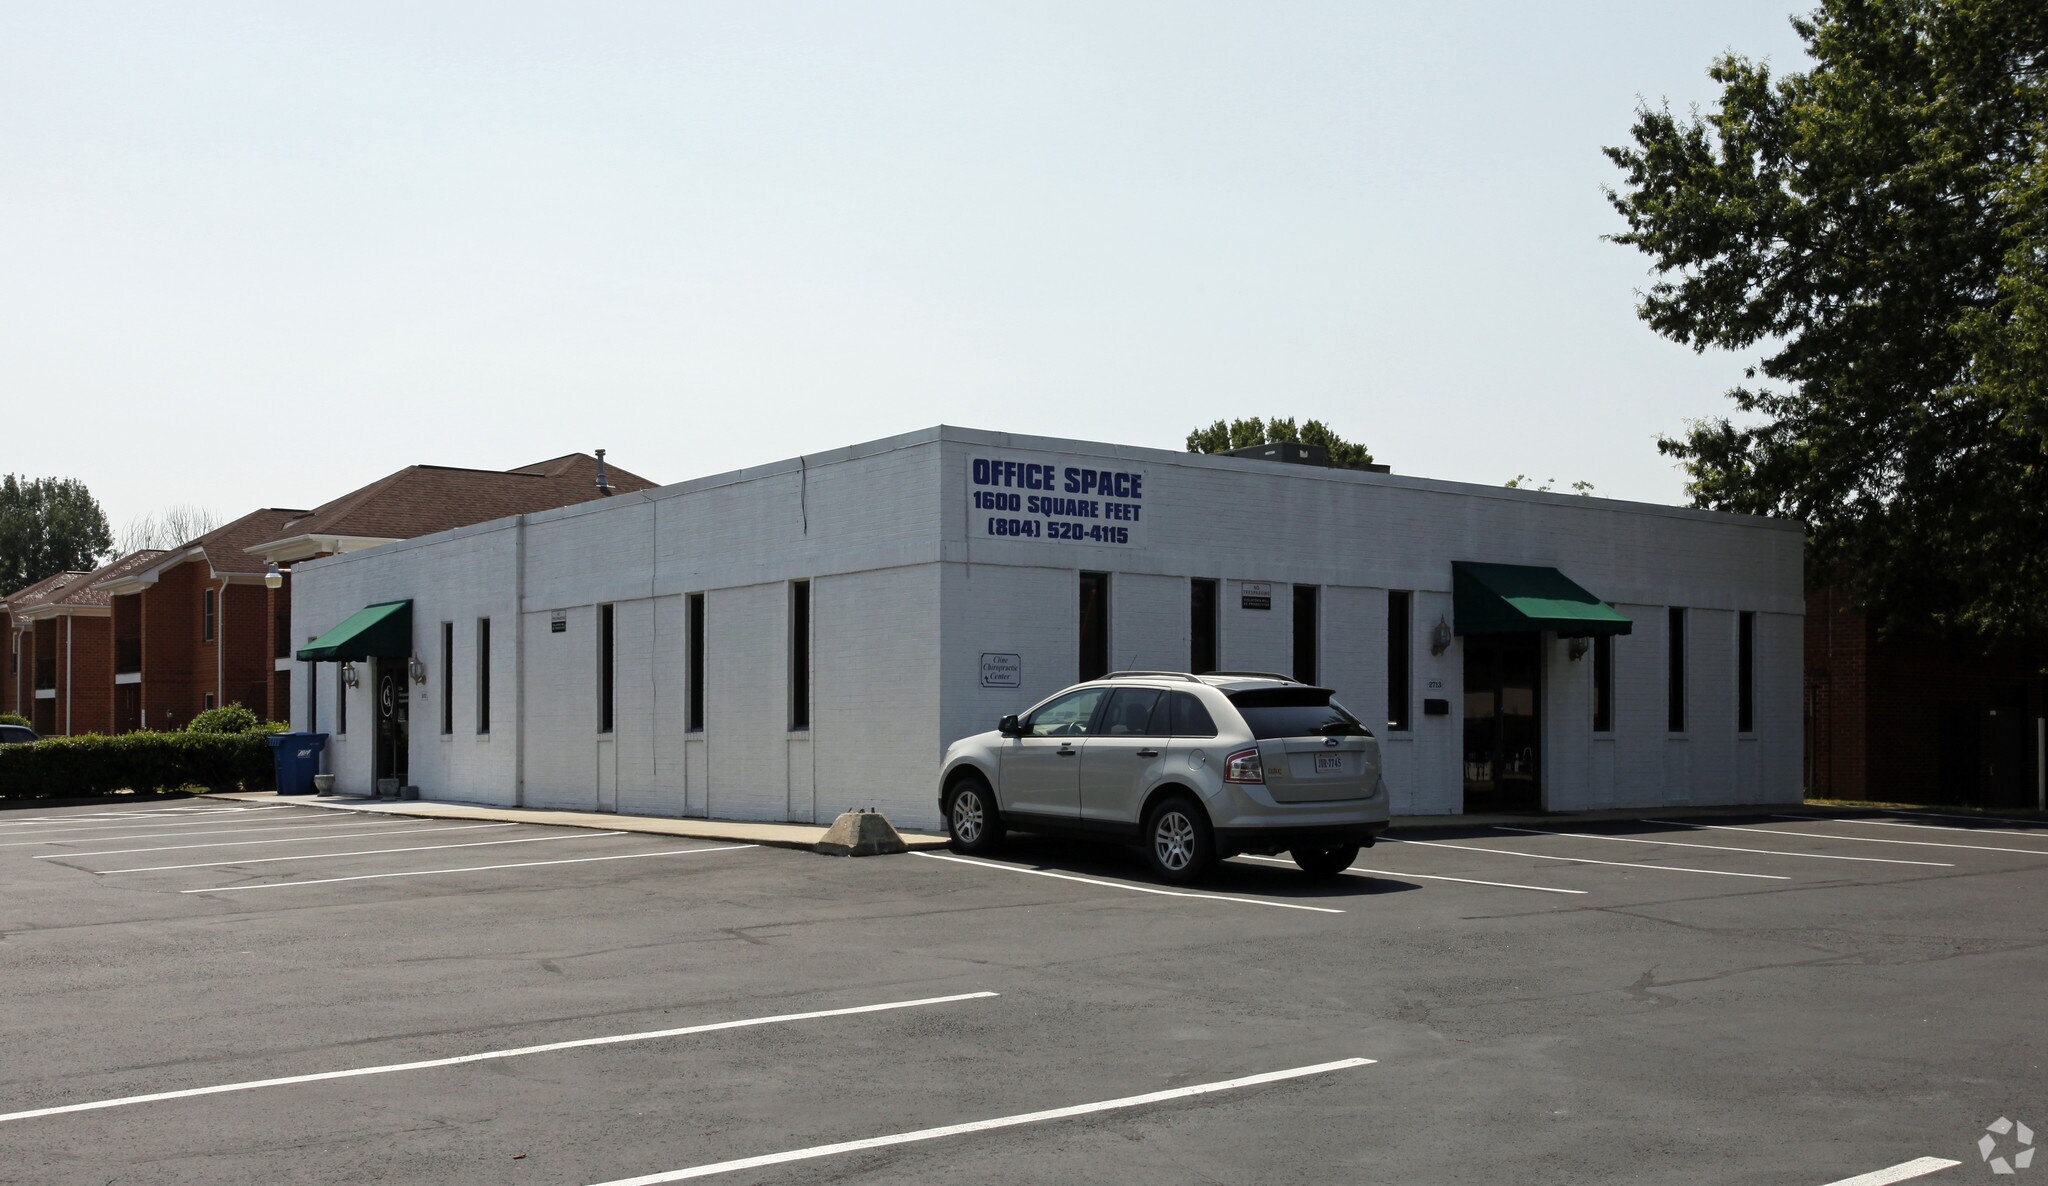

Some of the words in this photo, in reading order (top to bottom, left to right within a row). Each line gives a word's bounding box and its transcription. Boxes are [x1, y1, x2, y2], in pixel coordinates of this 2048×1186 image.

[973, 458, 1055, 491] OFFICE
[1064, 467, 1142, 499] SPACE
[973, 491, 1021, 512] 1600
[1027, 495, 1099, 518] SQUARE
[1105, 502, 1142, 521] FEET
[988, 517, 1041, 538] (804)
[1047, 521, 1128, 544] 520-4115
[983, 663, 1019, 672] Chiropractic
[990, 671, 1011, 680] Center
